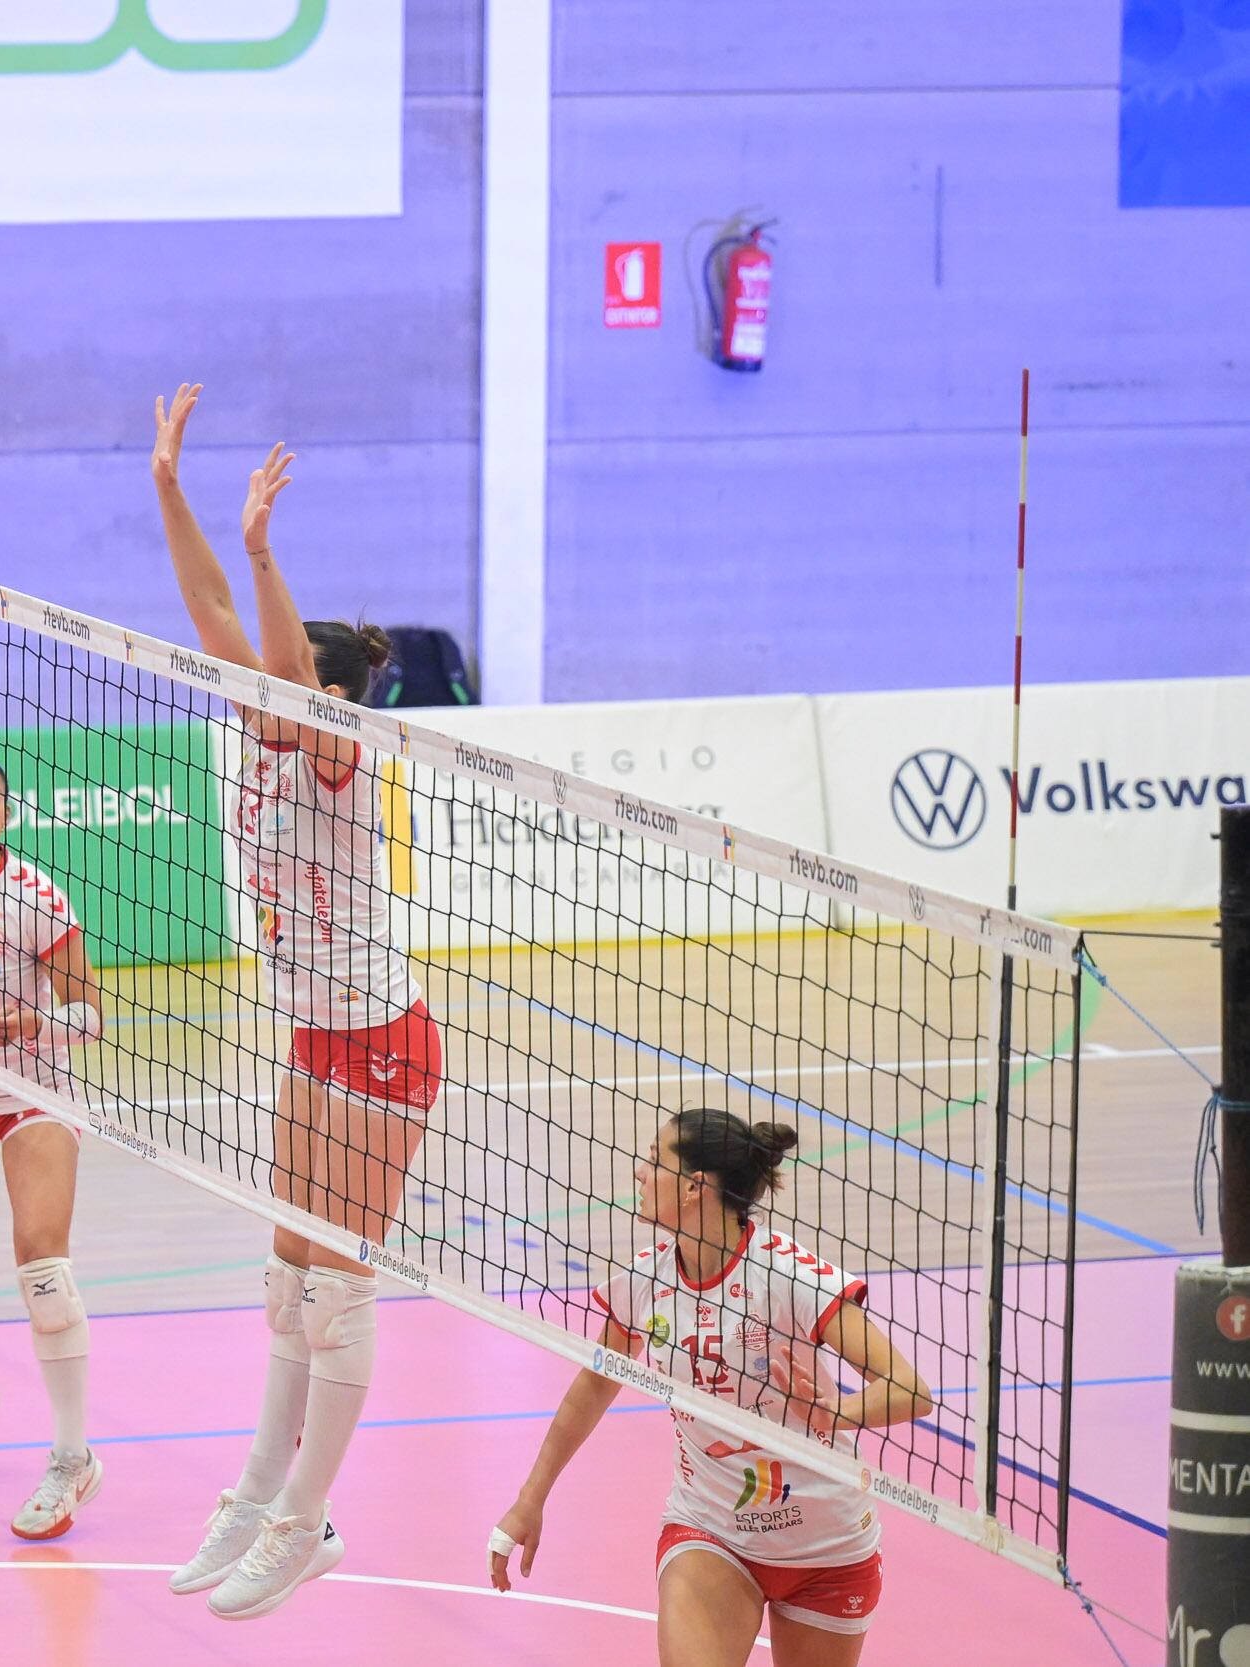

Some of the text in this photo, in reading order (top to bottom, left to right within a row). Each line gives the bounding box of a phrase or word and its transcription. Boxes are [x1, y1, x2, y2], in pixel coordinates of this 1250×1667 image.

[43, 606, 91, 641] rfevb.com
[169, 648, 222, 686] rfevb.com
[307, 694, 362, 732] rfevb.com
[454, 741, 514, 782] rfevb.com
[614, 793, 678, 836] rfevb.com
[789, 849, 858, 894] rfevb.com
[103, 1122, 157, 1160] cdheidelberg.es
[369, 1244, 429, 1291] @cdheidelberg
[605, 1353, 674, 1404] @CBHeidelberg
[680, 1334, 731, 1386] 15
[873, 1475, 939, 1524] cdheidelberg
[761, 1518, 804, 1533] BALEARS
